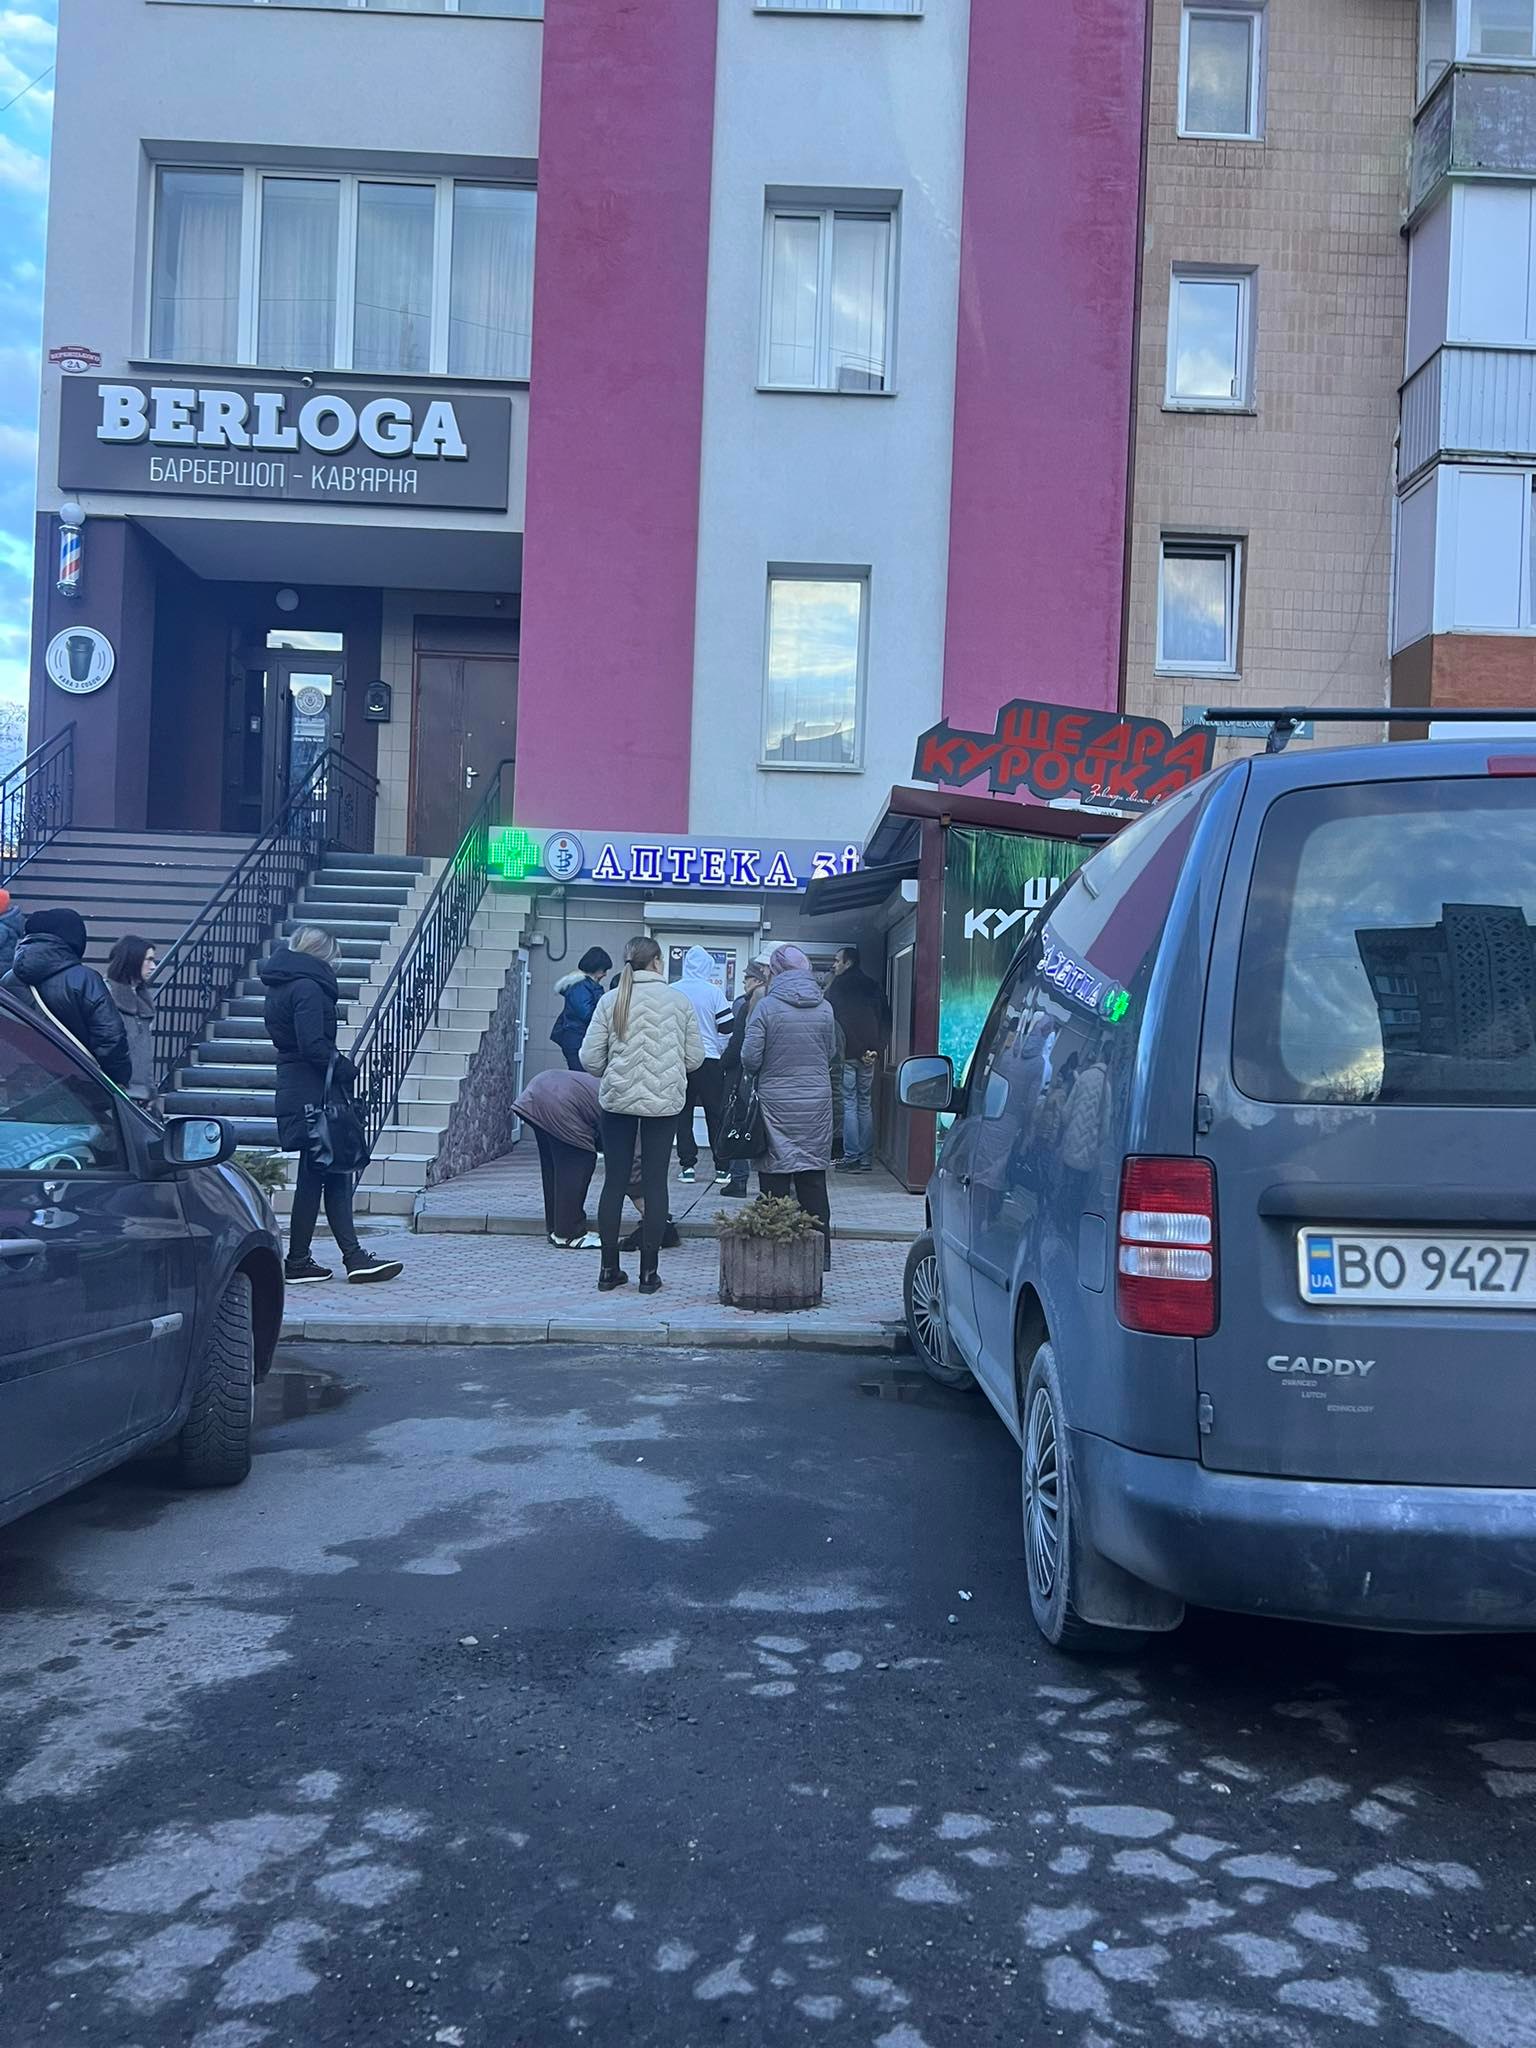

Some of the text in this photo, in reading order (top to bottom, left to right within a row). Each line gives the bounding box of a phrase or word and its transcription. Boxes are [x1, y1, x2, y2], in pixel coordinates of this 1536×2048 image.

[97, 385, 468, 460] BERLOGA
[150, 456, 284, 488] БАРБЕРШОП
[312, 465, 417, 494] КАВ'ЯРНЯ
[1001, 706, 1208, 781] ЩЕДРА
[592, 843, 797, 887] АПТЕКА
[1311, 1274, 1333, 1288] UA
[1338, 1244, 1530, 1292] BO 9427
[1267, 1355, 1377, 1377] CADDY
